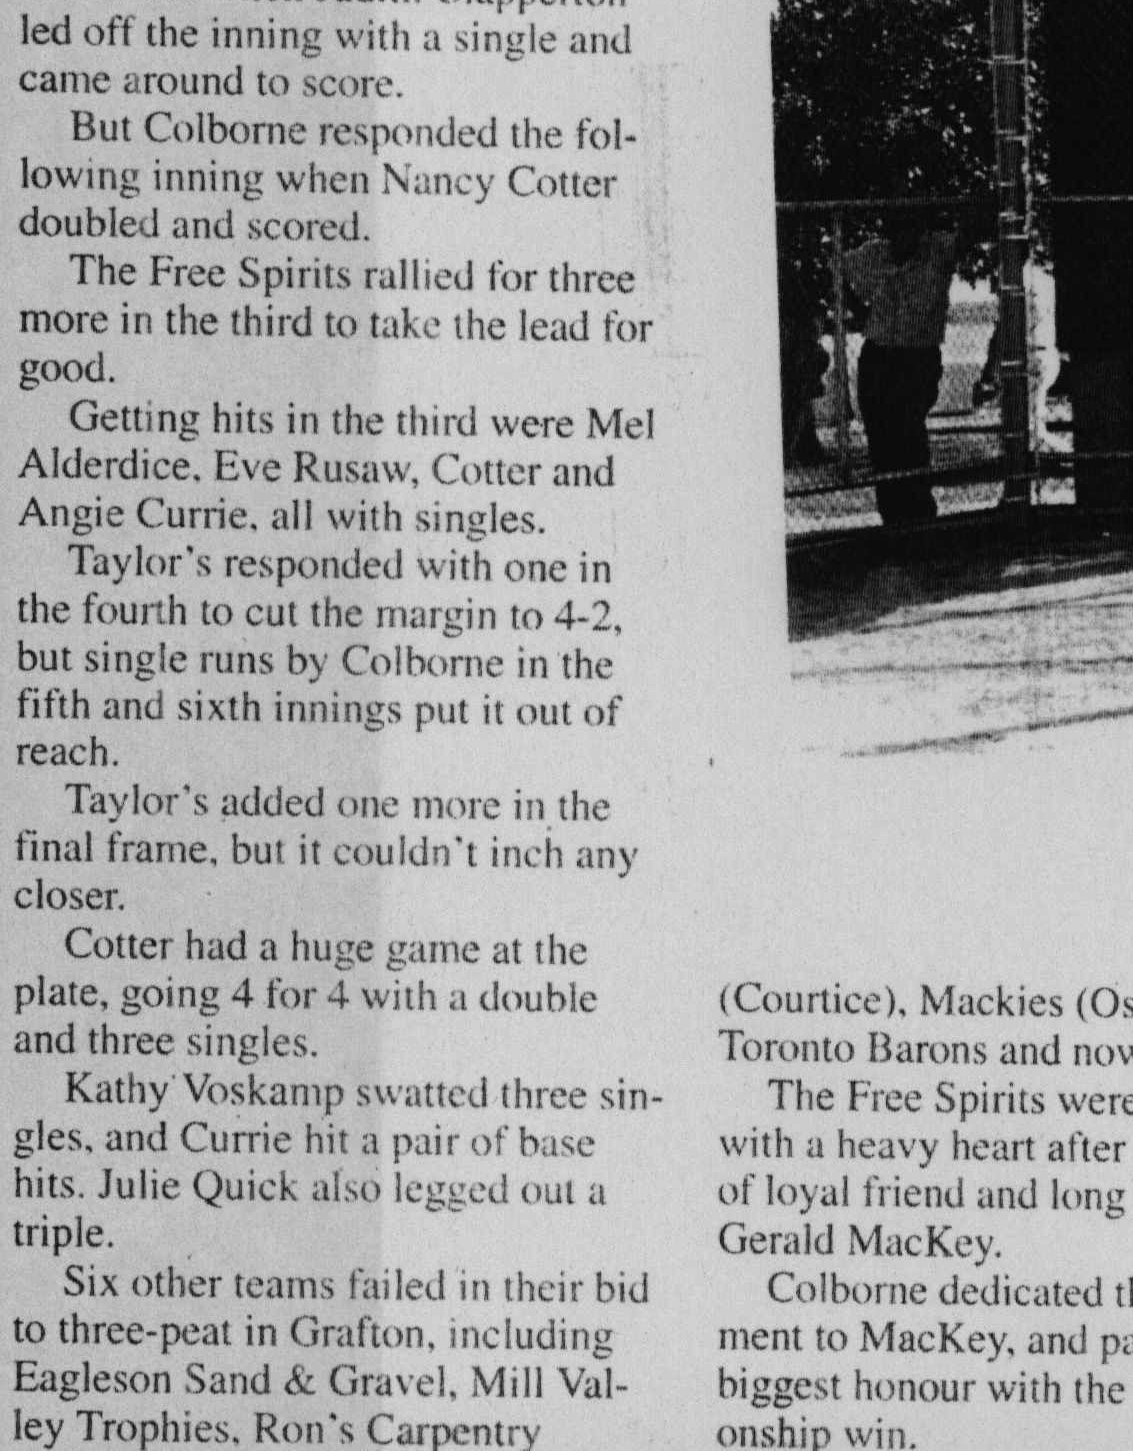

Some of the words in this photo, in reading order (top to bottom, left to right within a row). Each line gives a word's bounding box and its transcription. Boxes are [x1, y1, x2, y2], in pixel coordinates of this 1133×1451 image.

[20, 12, 72, 47] led
[83, 13, 136, 47] off
[146, 15, 199, 49] the
[211, 16, 322, 60] inning
[335, 18, 411, 52] with
[422, 29, 442, 53] a
[454, 20, 558, 63] single
[568, 23, 632, 56] and
[20, 155, 141, 200] lowing
[153, 158, 264, 202] inning
[275, 161, 370, 195] when
[382, 162, 495, 206] Nancy
[507, 164, 618, 199] Cotter
[68, 252, 138, 287] The
[149, 254, 226, 289] Free
[238, 255, 352, 299] Spirits
[364, 257, 475, 292] rallied
[487, 258, 539, 293] for
[548, 260, 636, 295] three
[18, 350, 116, 392] good.
[68, 398, 201, 443] Getting
[212, 400, 275, 435] hits
[286, 401, 319, 435] in
[331, 402, 385, 437] the
[396, 403, 478, 438] third
[490, 414, 575, 440] were
[586, 406, 655, 441] Mel
[16, 639, 73, 673] but
[84, 640, 188, 683] single
[199, 650, 275, 675] runs
[286, 643, 329, 685] by
[341, 643, 504, 679] Colborne
[517, 645, 549, 680] in
[561, 647, 614, 681] the
[16, 734, 119, 767] reach.
[64, 782, 209, 824] Taylor's
[220, 784, 325, 818] added
[336, 795, 399, 819] one
[412, 795, 501, 821] more
[513, 788, 545, 821] in
[558, 788, 611, 823] the
[13, 877, 125, 911] closer.
[64, 925, 175, 961] Cotter
[185, 927, 248, 962] had
[259, 938, 278, 962] a
[291, 928, 375, 972] huge
[385, 940, 481, 972] game
[491, 938, 523, 966] at
[534, 932, 588, 967] the
[13, 1021, 77, 1055] and
[87, 1022, 175, 1057] three
[187, 1023, 318, 1066] singles.
[717, 1028, 856, 1064] Toronto
[868, 1030, 988, 1066] Barons
[999, 1033, 1062, 1067] and
[65, 1070, 169, 1114] Kathy
[182, 1072, 345, 1116] Voskamp
[356, 1075, 489, 1109] swatted
[500, 1076, 588, 1110] three
[600, 1077, 664, 1111] sin-
[767, 1077, 835, 1112] The
[848, 1079, 923, 1114] Free
[934, 1080, 1046, 1123] Spirits
[717, 1172, 757, 1206] of
[765, 1173, 850, 1216] loyal
[863, 1174, 965, 1209] friend
[976, 1177, 1038, 1211] and
[1051, 1177, 1126, 1221] long
[12, 1213, 114, 1258] triple.
[717, 1221, 835, 1256] Gerald
[848, 1223, 1002, 1268] MacKey.
[12, 1316, 47, 1345] to
[58, 1311, 232, 1356] three-peat
[245, 1313, 277, 1347] in
[289, 1314, 436, 1353] Grafton,
[449, 1317, 614, 1361] including
[718, 1325, 804, 1352] ment
[815, 1325, 849, 1353] to
[859, 1320, 1016, 1364] MacKey,
[1026, 1323, 1088, 1356] and
[717, 1366, 842, 1410] biggest
[854, 1368, 977, 1404] honour
[987, 1370, 1062, 1405] with
[1074, 1371, 1126, 1406] the
